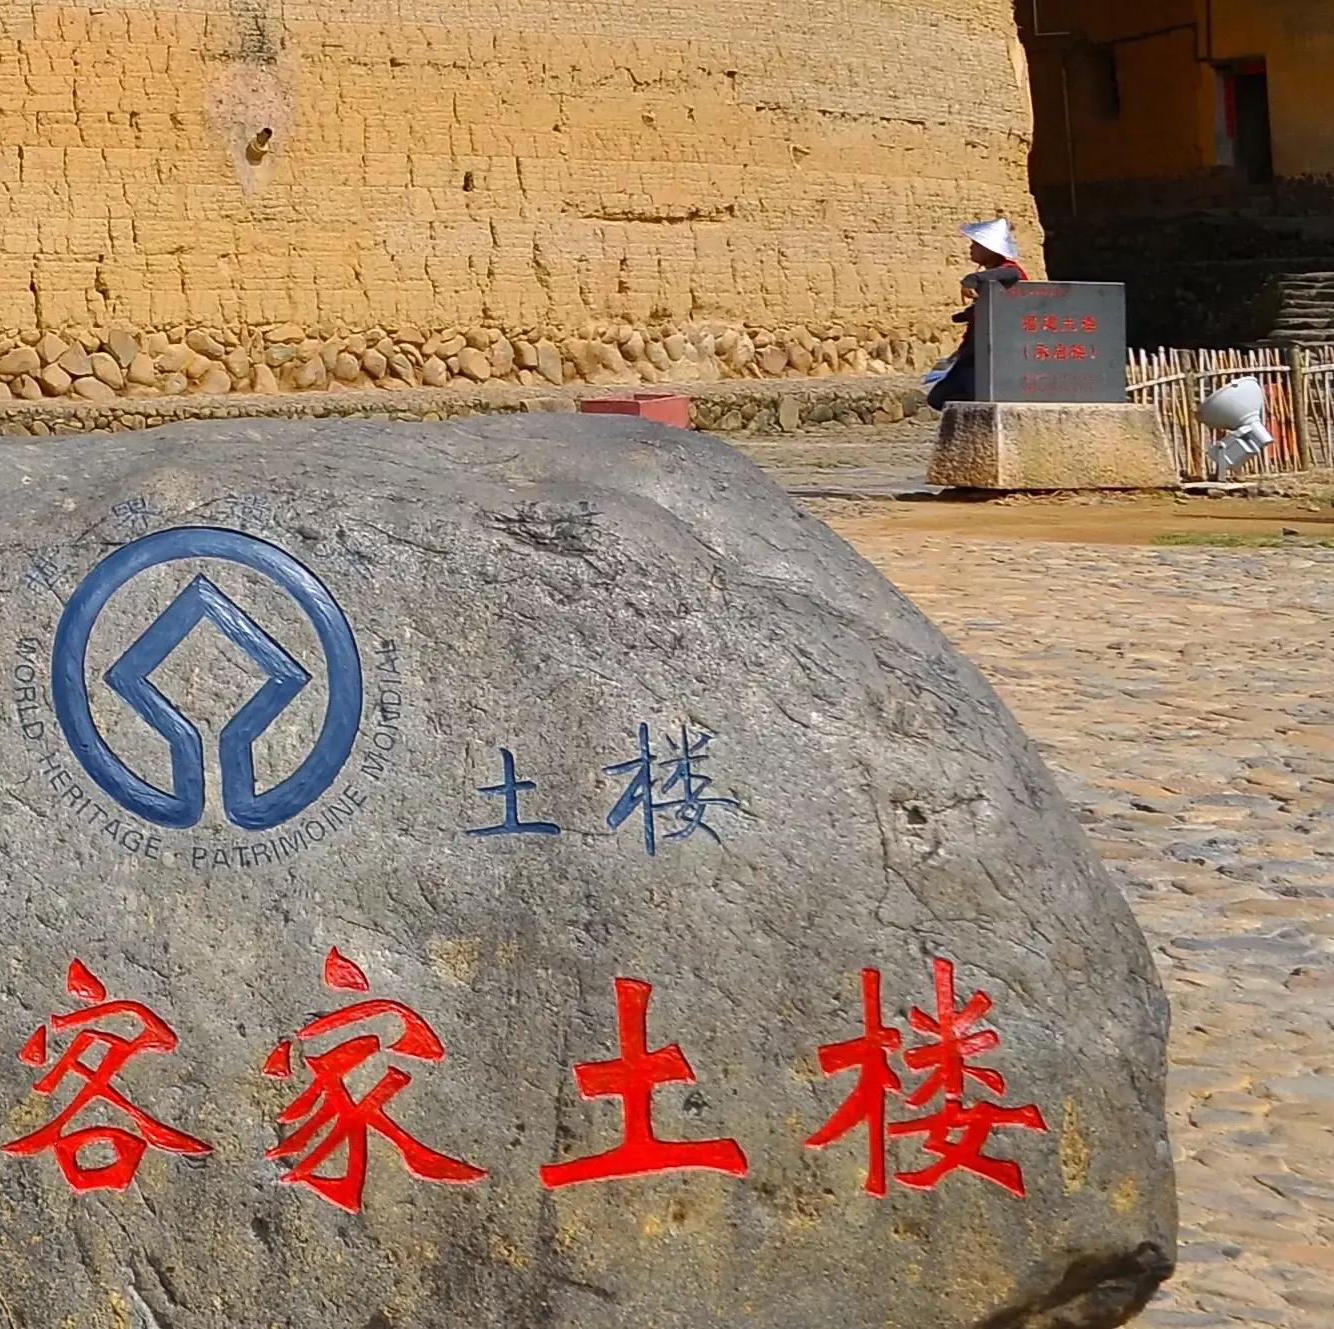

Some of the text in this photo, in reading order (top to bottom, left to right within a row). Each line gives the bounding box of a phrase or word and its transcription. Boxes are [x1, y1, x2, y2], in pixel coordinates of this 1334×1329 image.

[14, 637, 403, 870] WORLD HERITAGE PATRIMOINE MONDIAL
[463, 721, 738, 858] 土楼
